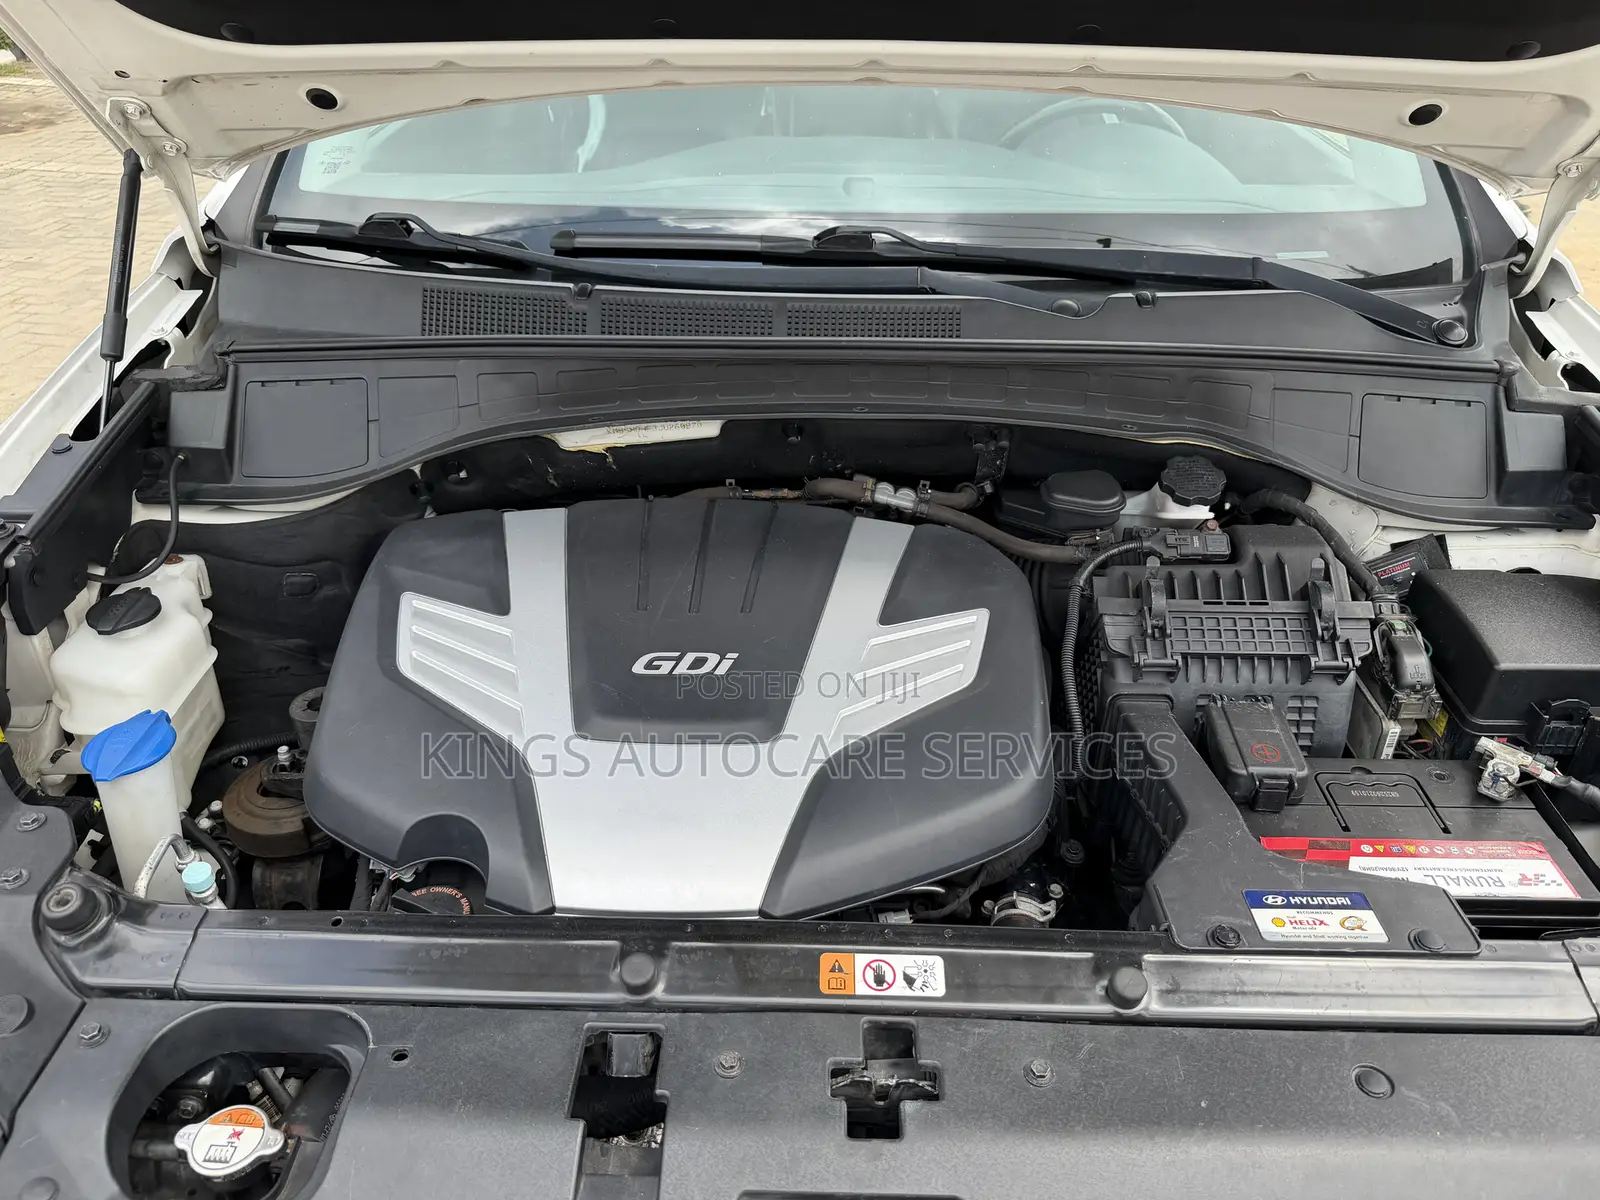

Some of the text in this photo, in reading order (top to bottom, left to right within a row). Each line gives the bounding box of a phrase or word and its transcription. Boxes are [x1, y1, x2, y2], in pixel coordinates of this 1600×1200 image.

[1377, 562, 1411, 577] PLATINUM
[631, 651, 739, 675] GDi
[1423, 874, 1506, 888] RUNALL
[430, 886, 463, 899] OWNER'S
[1288, 895, 1352, 905] HYUNDAI
